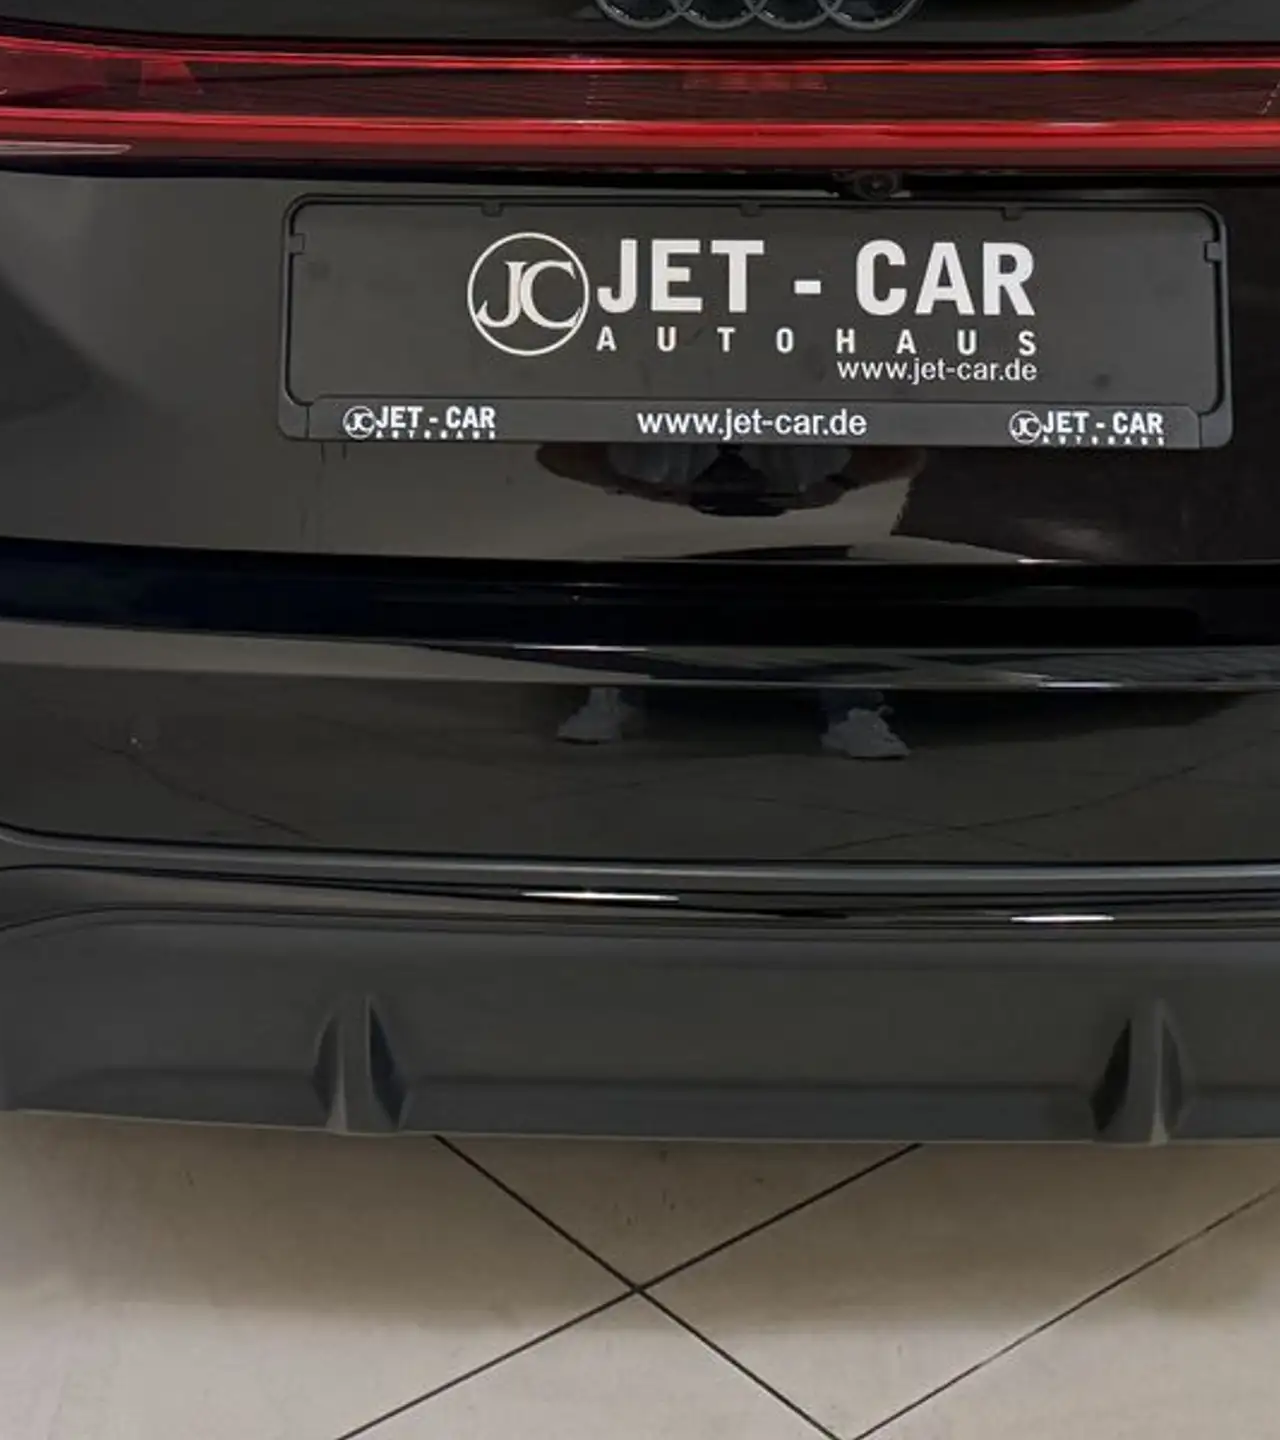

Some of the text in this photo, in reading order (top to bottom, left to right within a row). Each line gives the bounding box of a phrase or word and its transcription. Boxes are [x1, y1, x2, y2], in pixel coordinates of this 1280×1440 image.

[473, 237, 1037, 332] JC JET - CAR
[595, 324, 1038, 357] AUTOHAUS
[836, 357, 1038, 387] www.jet-car.de
[375, 405, 424, 429] JET
[445, 405, 496, 430] CAR
[636, 407, 868, 442] www.jet-car.de
[1042, 410, 1091, 434] JET
[1112, 410, 1165, 436] CAR
